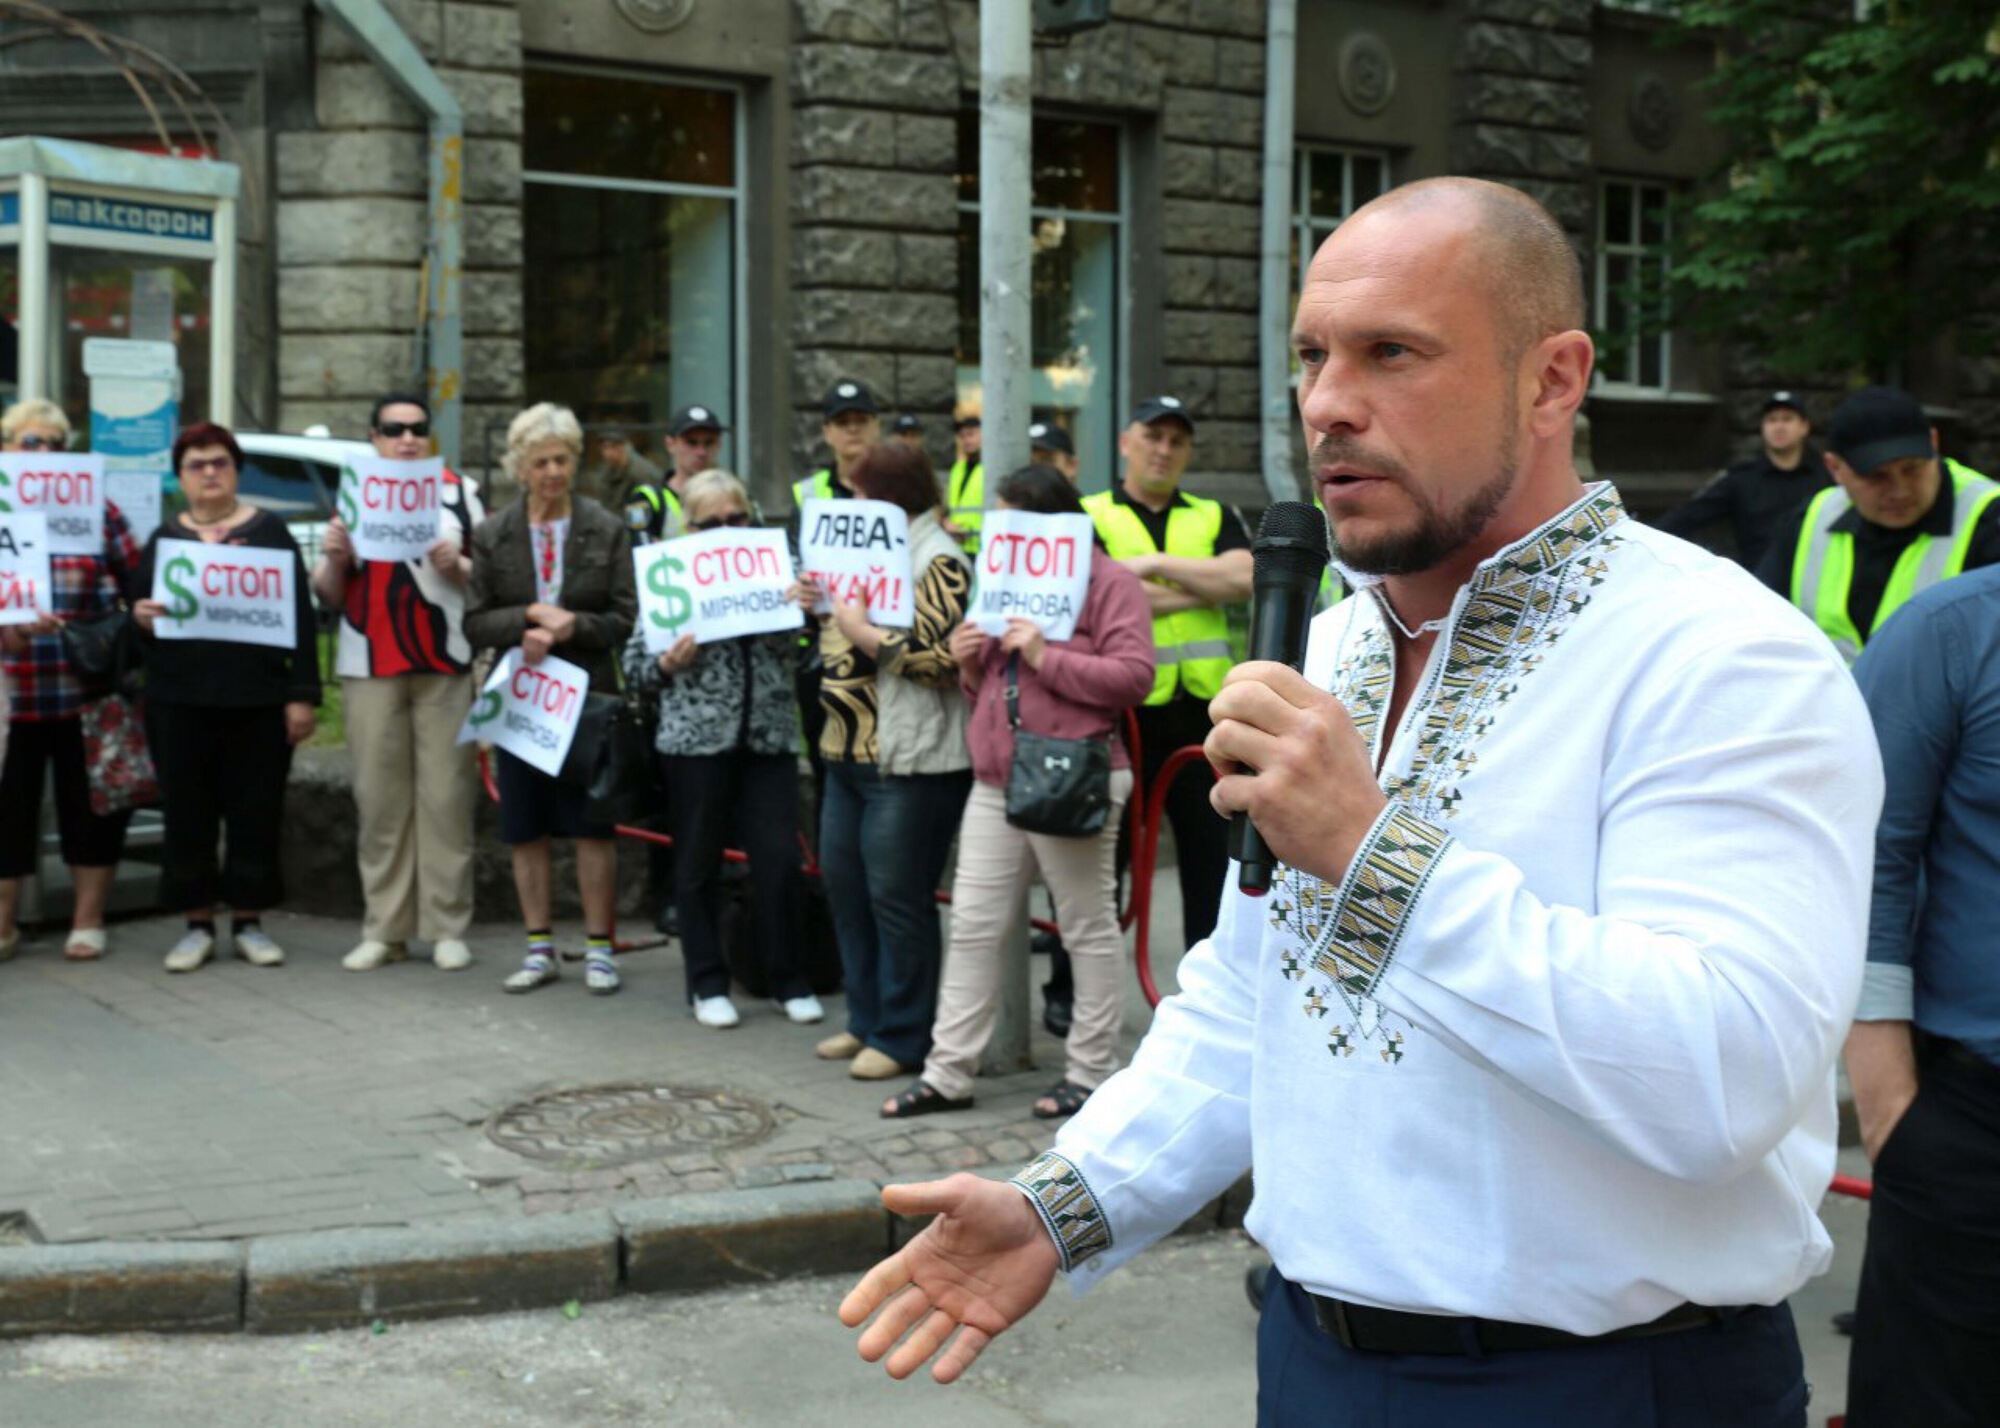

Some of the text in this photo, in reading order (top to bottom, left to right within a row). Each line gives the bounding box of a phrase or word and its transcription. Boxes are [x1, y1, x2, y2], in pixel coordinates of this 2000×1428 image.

[18, 471, 93, 505] СТОП
[363, 475, 437, 513] СТОП
[810, 514, 905, 551] ЛЯВА-
[692, 546, 780, 586] СТОП
[987, 533, 1075, 578] СТОП
[202, 564, 282, 600] СТОП
[700, 589, 790, 620] МІРНОВА
[983, 591, 1072, 617] МІРНОВА
[511, 666, 578, 723] СТОП
